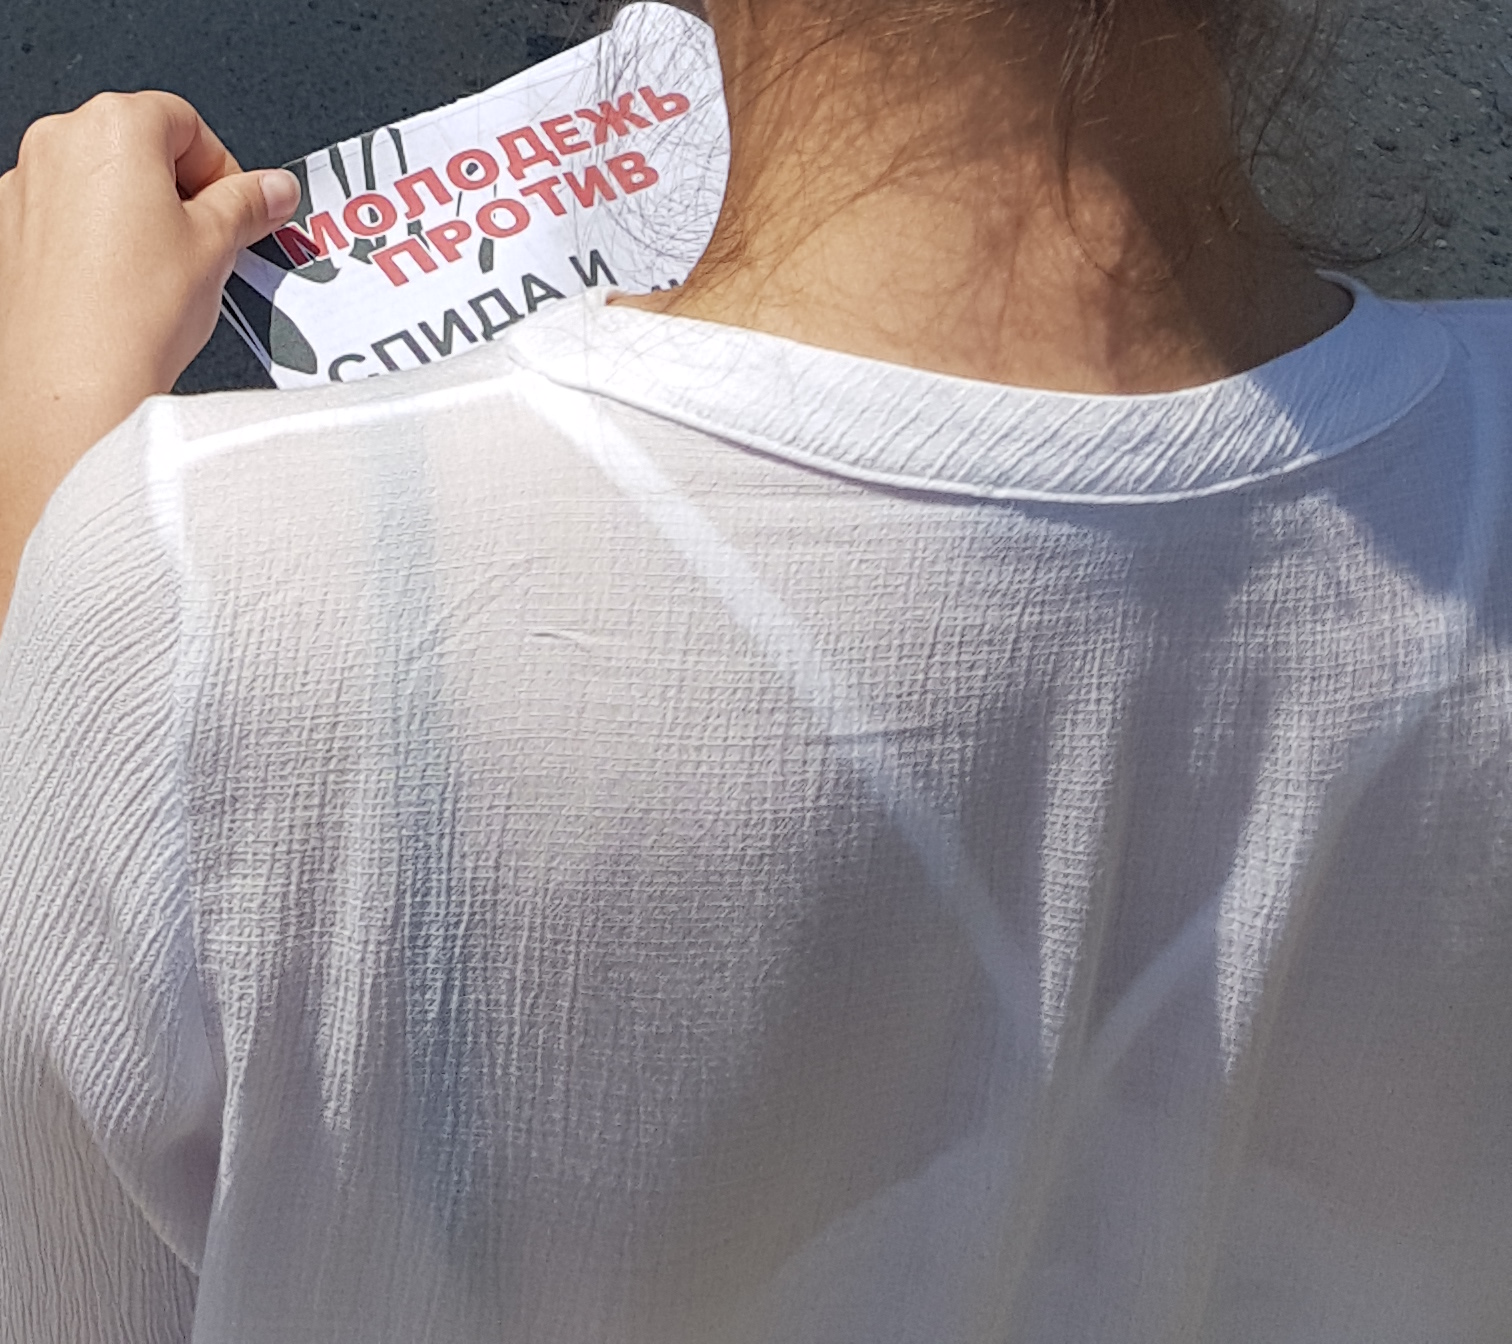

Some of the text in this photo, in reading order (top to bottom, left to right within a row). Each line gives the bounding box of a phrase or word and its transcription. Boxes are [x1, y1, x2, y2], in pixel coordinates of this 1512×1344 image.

[273, 85, 690, 268] МОЛОДЕЖЬ
[369, 151, 659, 286] ПРОТИВ
[328, 248, 619, 383] СПИДА И
